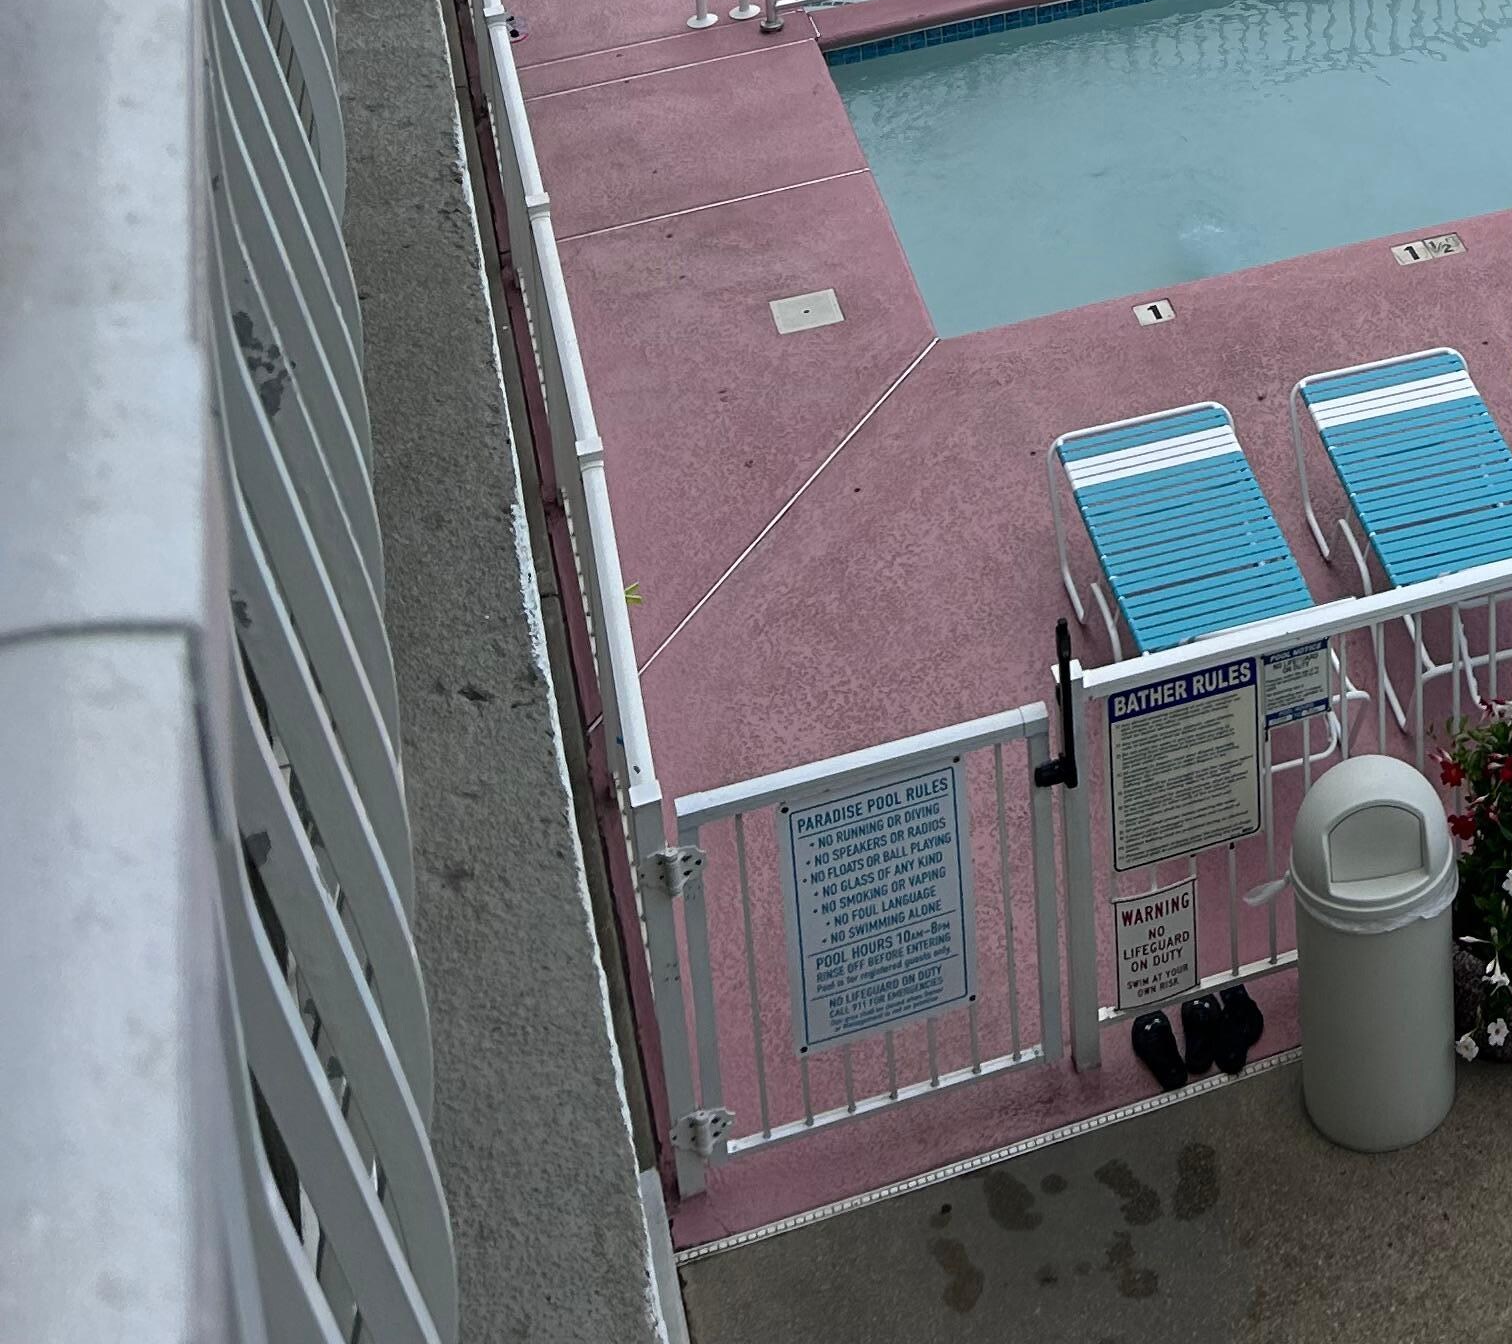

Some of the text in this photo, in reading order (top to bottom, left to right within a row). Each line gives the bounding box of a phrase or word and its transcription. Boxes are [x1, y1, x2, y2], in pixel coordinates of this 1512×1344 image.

[1403, 245, 1420, 260] 1
[1147, 305, 1162, 319] 1
[1113, 679, 1188, 717] BATHER
[1192, 662, 1252, 696] RULES
[797, 777, 949, 834] PARADISE POOL RULES
[814, 816, 946, 867] NO SPEAKERS OR RADIOS
[818, 802, 940, 849] NO RUNNING OR DIVING
[810, 832, 952, 885] NO FLOATS OR BALL PLAYING
[822, 851, 943, 898] NO GLASS OF ANY KIND
[821, 866, 946, 915] NO SMOKING OR VAPING
[834, 885, 937, 927] NO FOUL LANGUAGE
[1121, 892, 1189, 927] WARNING
[830, 899, 942, 945] NO SWIMMING ALONE
[1148, 925, 1165, 940] NO
[816, 952, 846, 971] POOL
[852, 935, 893, 958] HOURS
[816, 933, 952, 983] RINSE OFF BEFORE ENTERING
[1123, 930, 1190, 960] LIFEGUARD
[1131, 946, 1183, 972] ON DUTY
[829, 964, 942, 1009] NO LIFEGUARD ON DUTY
[846, 973, 859, 985] for
[861, 961, 902, 980] registered
[904, 951, 932, 969] guests
[1127, 963, 1188, 990] SWIM AT YOUR
[1137, 977, 1179, 997] OWN RISK
[829, 1005, 850, 1019] CALL
[852, 999, 867, 1012] 911
